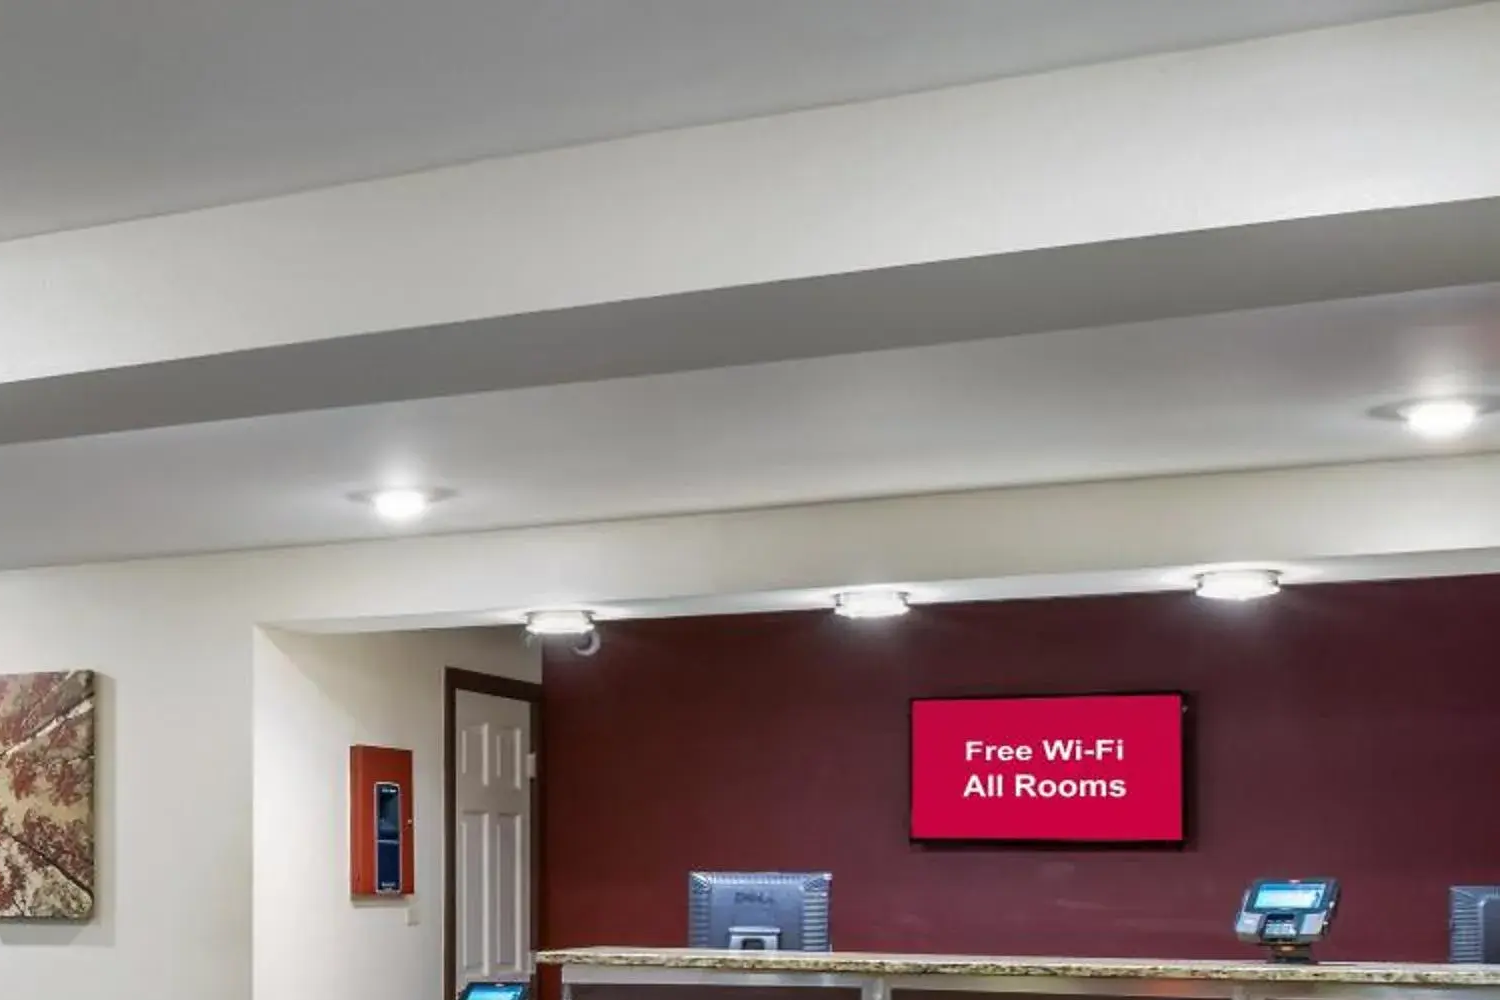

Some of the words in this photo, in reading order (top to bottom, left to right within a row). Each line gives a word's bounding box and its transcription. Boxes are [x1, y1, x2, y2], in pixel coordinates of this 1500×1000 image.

[965, 740, 1033, 761] Free
[1042, 739, 1124, 761] Wi-Fi
[963, 774, 1003, 798] All
[1015, 774, 1127, 798] Rooms
